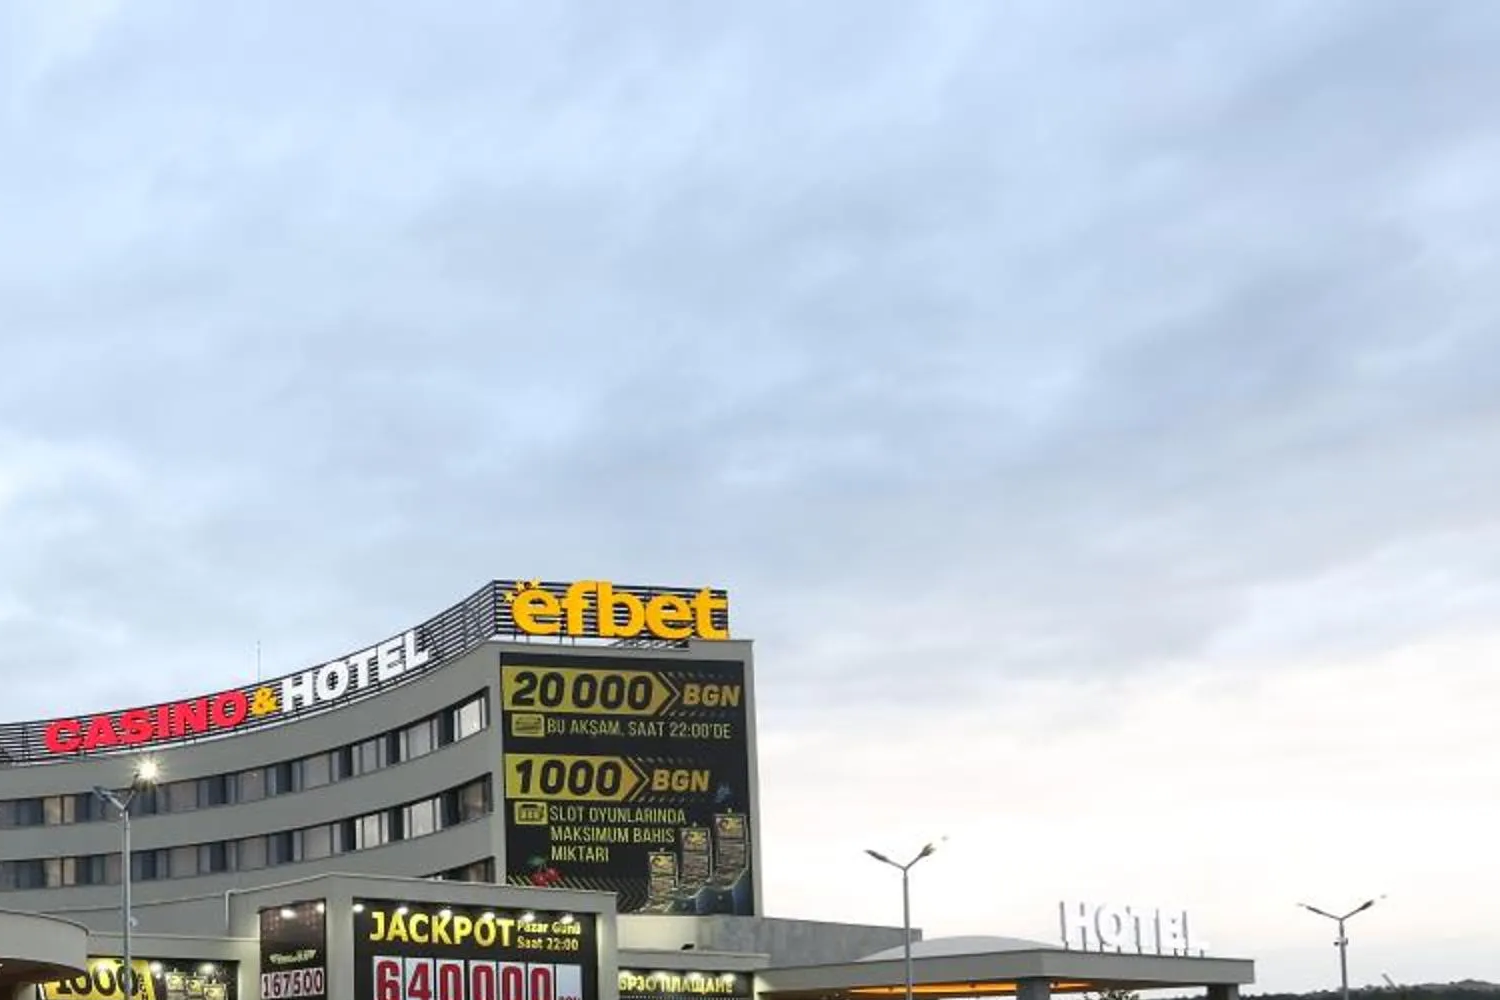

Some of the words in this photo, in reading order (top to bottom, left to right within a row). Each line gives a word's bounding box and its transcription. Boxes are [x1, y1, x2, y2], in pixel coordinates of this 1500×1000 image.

[508, 579, 729, 640] efbet
[44, 689, 249, 754] CASINO
[278, 630, 430, 713] HOTEL
[683, 683, 740, 706] BGN
[547, 718, 565, 734] BU
[628, 721, 664, 737] SAAT
[515, 759, 622, 797] 1000
[653, 769, 709, 792] BGN
[550, 805, 584, 822] SLOT
[589, 807, 687, 825] OYUNLARINDA
[633, 828, 675, 843] BAHIS
[369, 911, 515, 947] JACKPOT
[1059, 900, 1210, 951] HOTEL
[517, 936, 543, 949] Saat
[547, 937, 579, 951] 22:00
[262, 969, 323, 997] 167500
